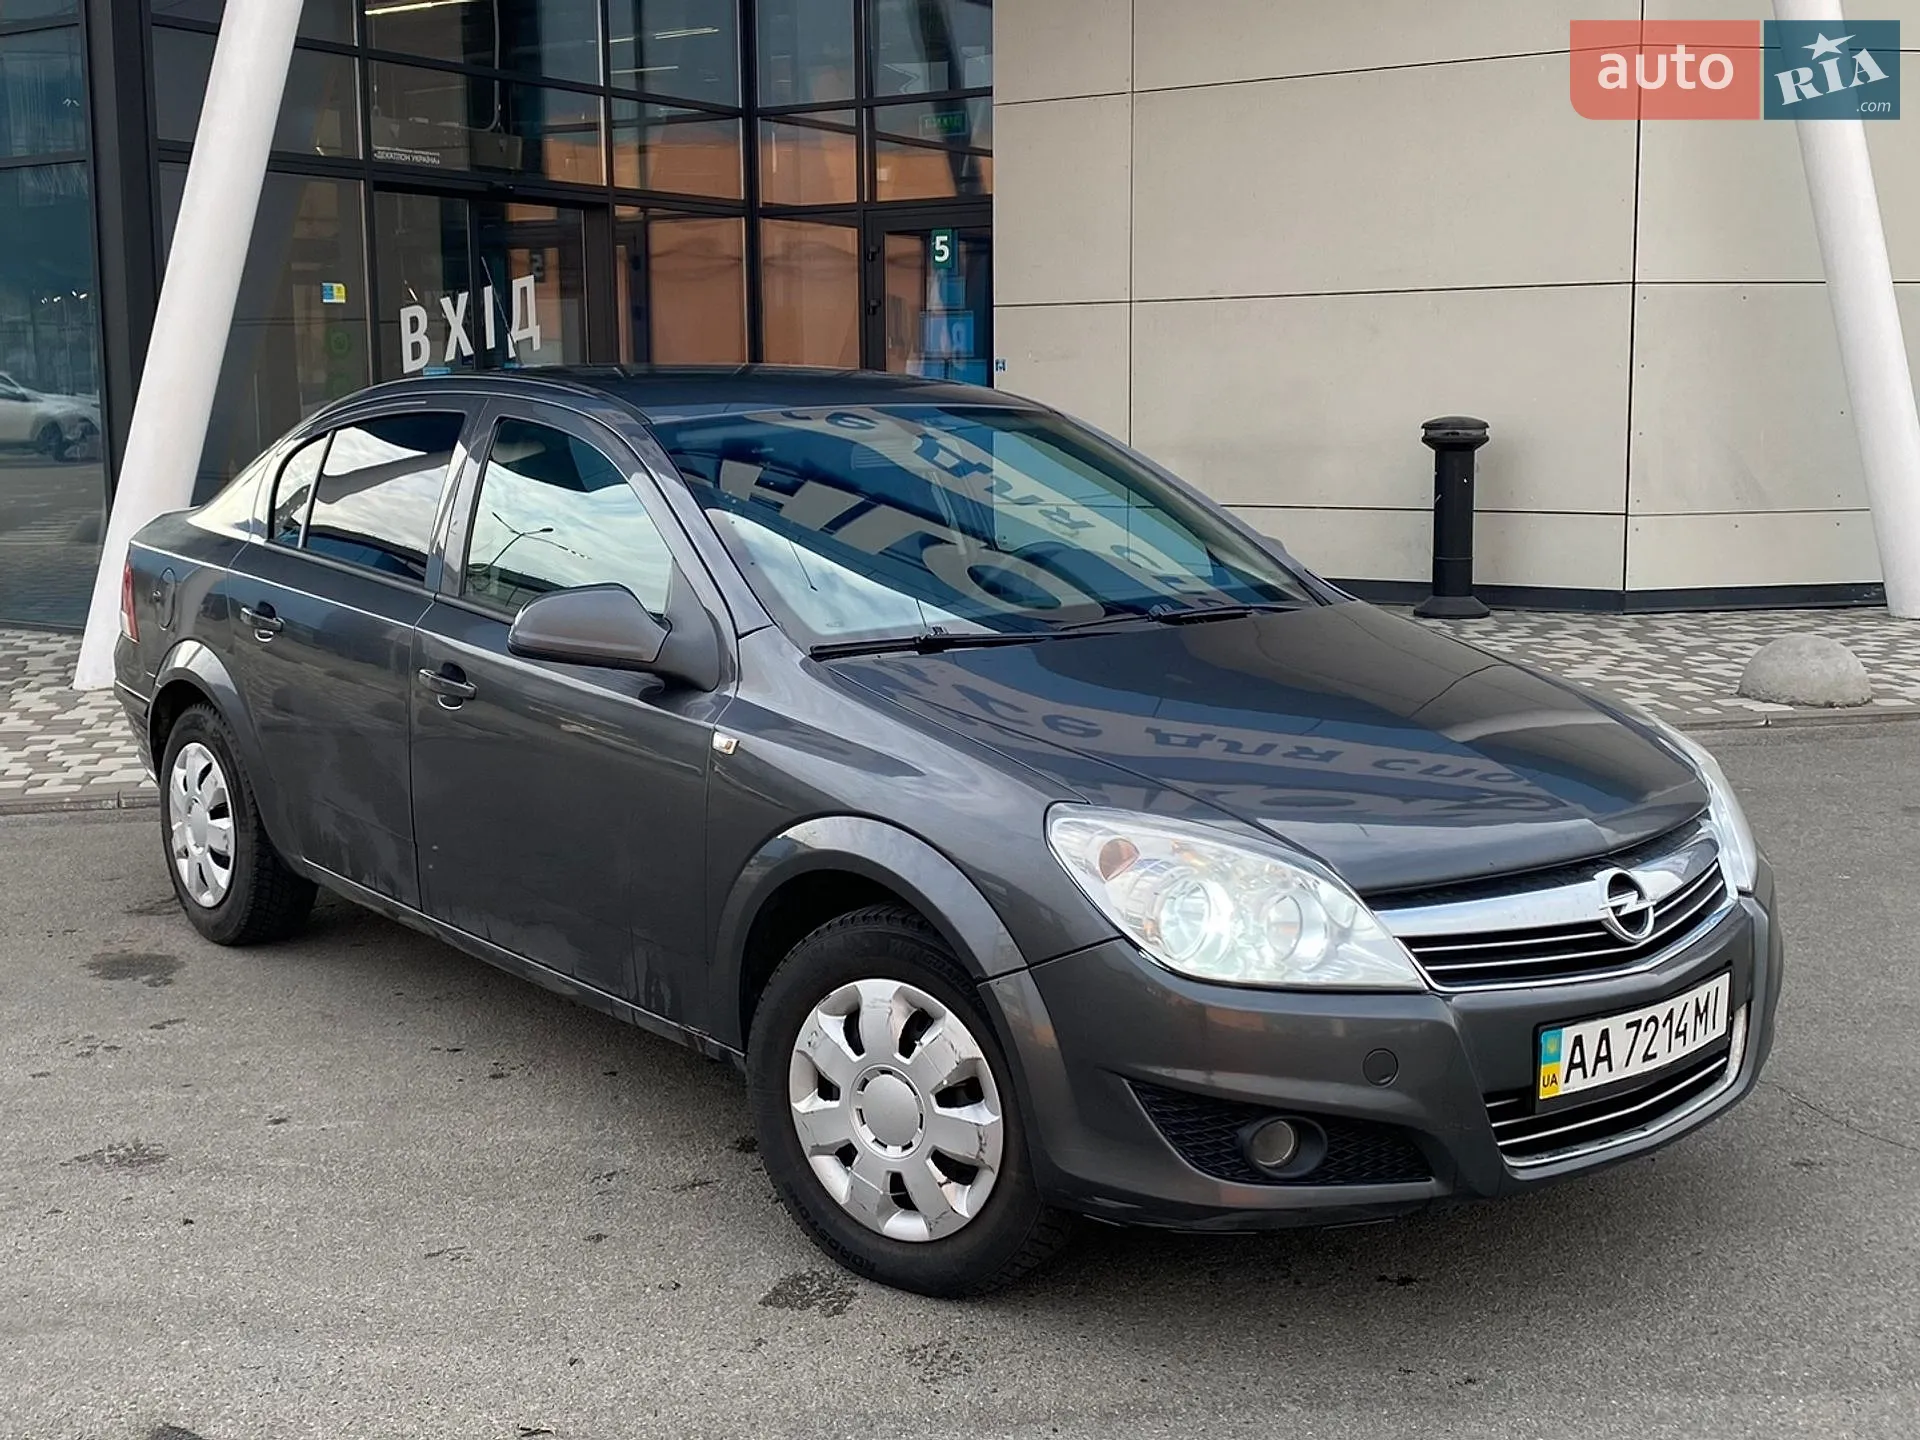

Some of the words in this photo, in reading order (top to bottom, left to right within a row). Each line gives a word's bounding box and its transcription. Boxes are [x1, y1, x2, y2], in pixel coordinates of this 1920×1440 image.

[934, 235, 950, 262] 5
[400, 274, 541, 374] ВХІД
[1564, 1027, 1613, 1084] AA
[1542, 1073, 1559, 1088] UA
